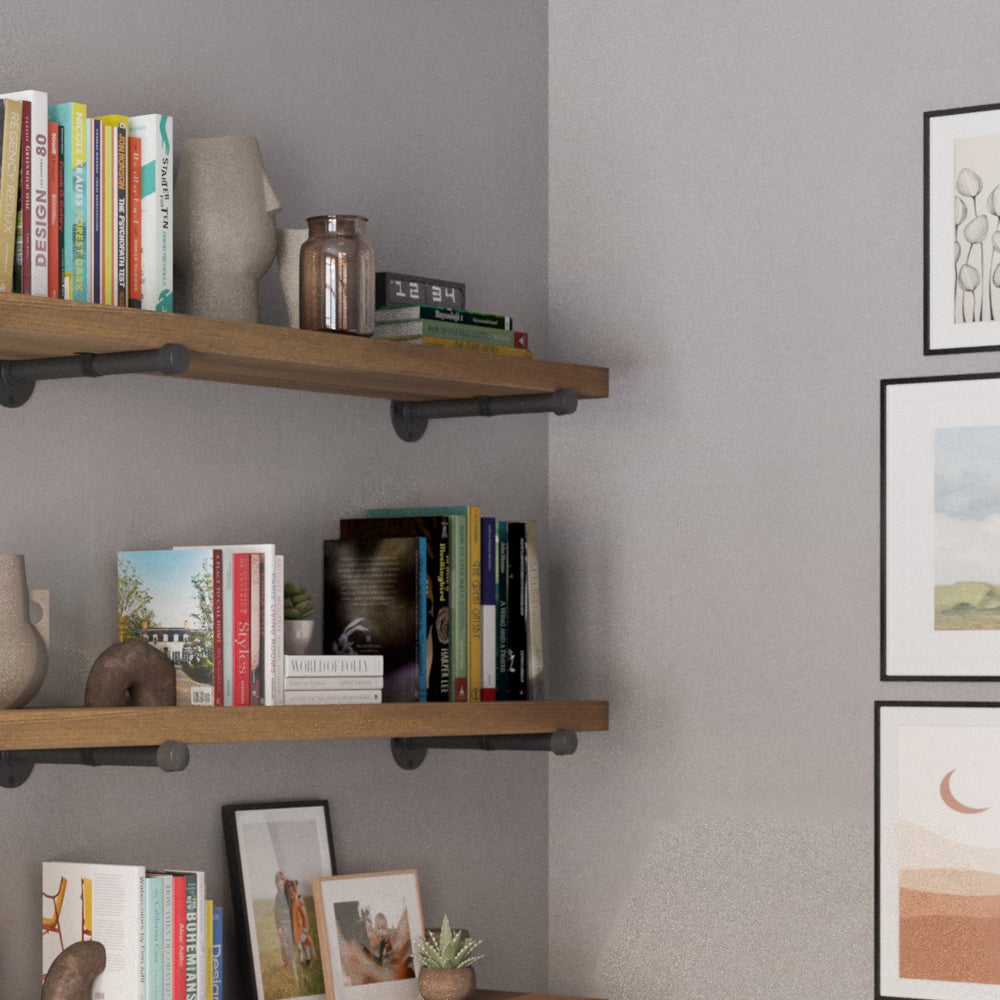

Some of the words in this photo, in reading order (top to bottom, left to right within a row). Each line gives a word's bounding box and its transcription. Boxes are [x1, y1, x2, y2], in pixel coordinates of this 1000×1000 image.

[7, 112, 19, 183] REGENCY
[36, 134, 46, 156] 80
[76, 111, 84, 155] NICOLE
[118, 133, 126, 156] JON
[75, 159, 84, 206] KRAUSS
[118, 157, 126, 190] RONSON
[3, 185, 16, 234] REDUX
[118, 198, 126, 213] THE
[35, 190, 46, 267] DESIGN
[75, 210, 84, 254] FOREST
[118, 215, 126, 267] PSYCHOPATH
[75, 259, 84, 291] DARK
[118, 268, 126, 288] TEST
[432, 286, 456, 303] 34
[437, 543, 446, 602] Mockingbird
[234, 621, 249, 675] Styles
[440, 648, 449, 676] HARPER
[440, 679, 449, 694] LEE
[139, 932, 144, 944] by
